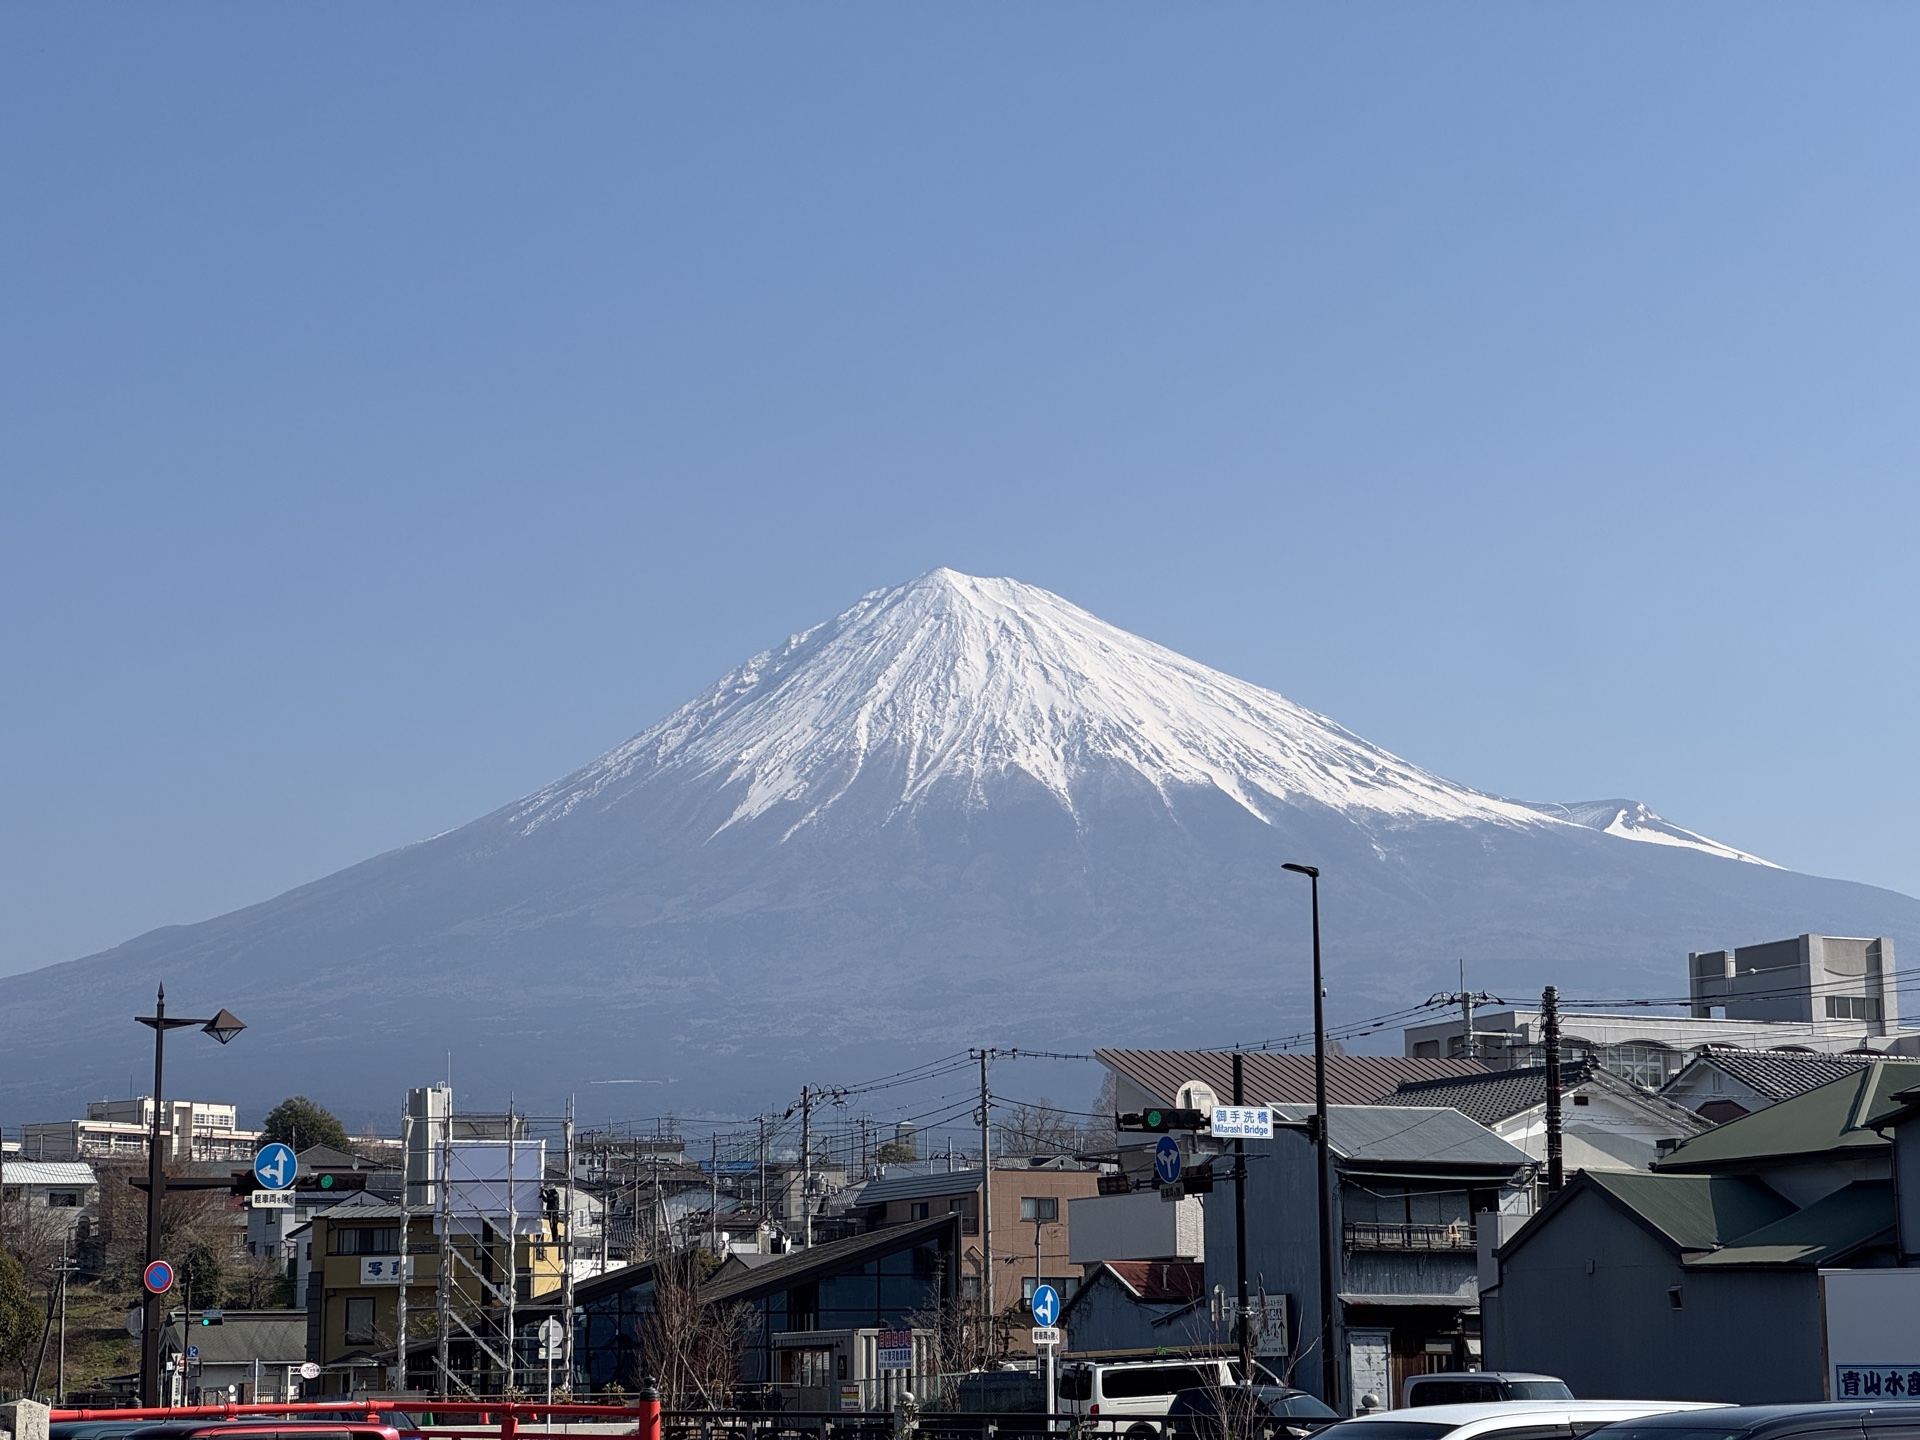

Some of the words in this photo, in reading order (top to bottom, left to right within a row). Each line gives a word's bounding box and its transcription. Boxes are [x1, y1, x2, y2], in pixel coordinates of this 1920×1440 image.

[1216, 1110, 1268, 1124] 御手洗橋
[1215, 1124, 1242, 1133] Mitarashi
[1244, 1125, 1268, 1135] Bridge
[254, 1194, 294, 1204] 軽車両を除く
[1841, 1370, 1920, 1396] 青山水産
